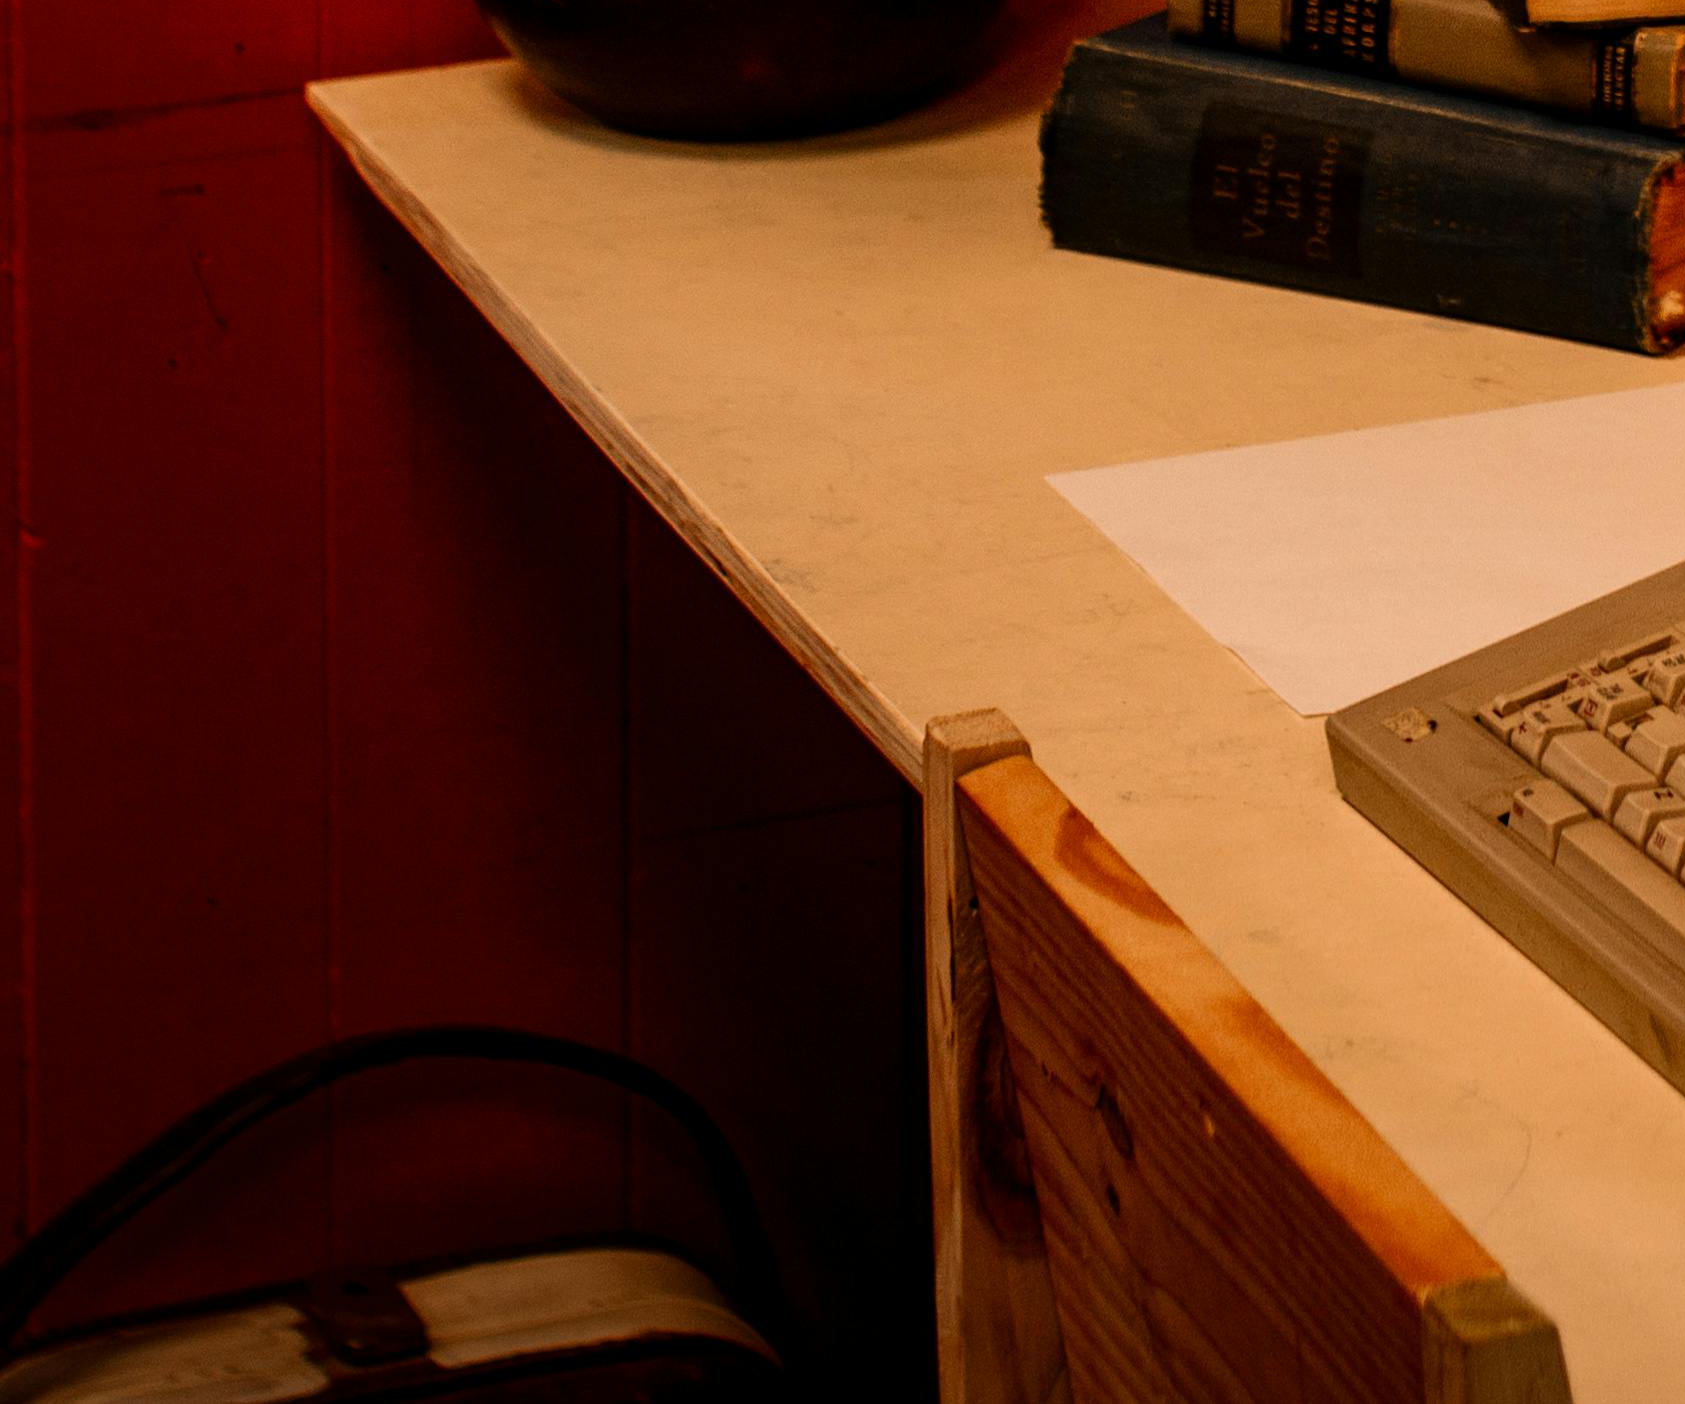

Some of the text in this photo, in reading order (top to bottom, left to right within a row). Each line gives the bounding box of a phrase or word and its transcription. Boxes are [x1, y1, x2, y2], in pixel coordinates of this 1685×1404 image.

[1240, 130, 1277, 239] Vuelco
[1275, 169, 1303, 220] del
[1302, 135, 1341, 261] Destino
